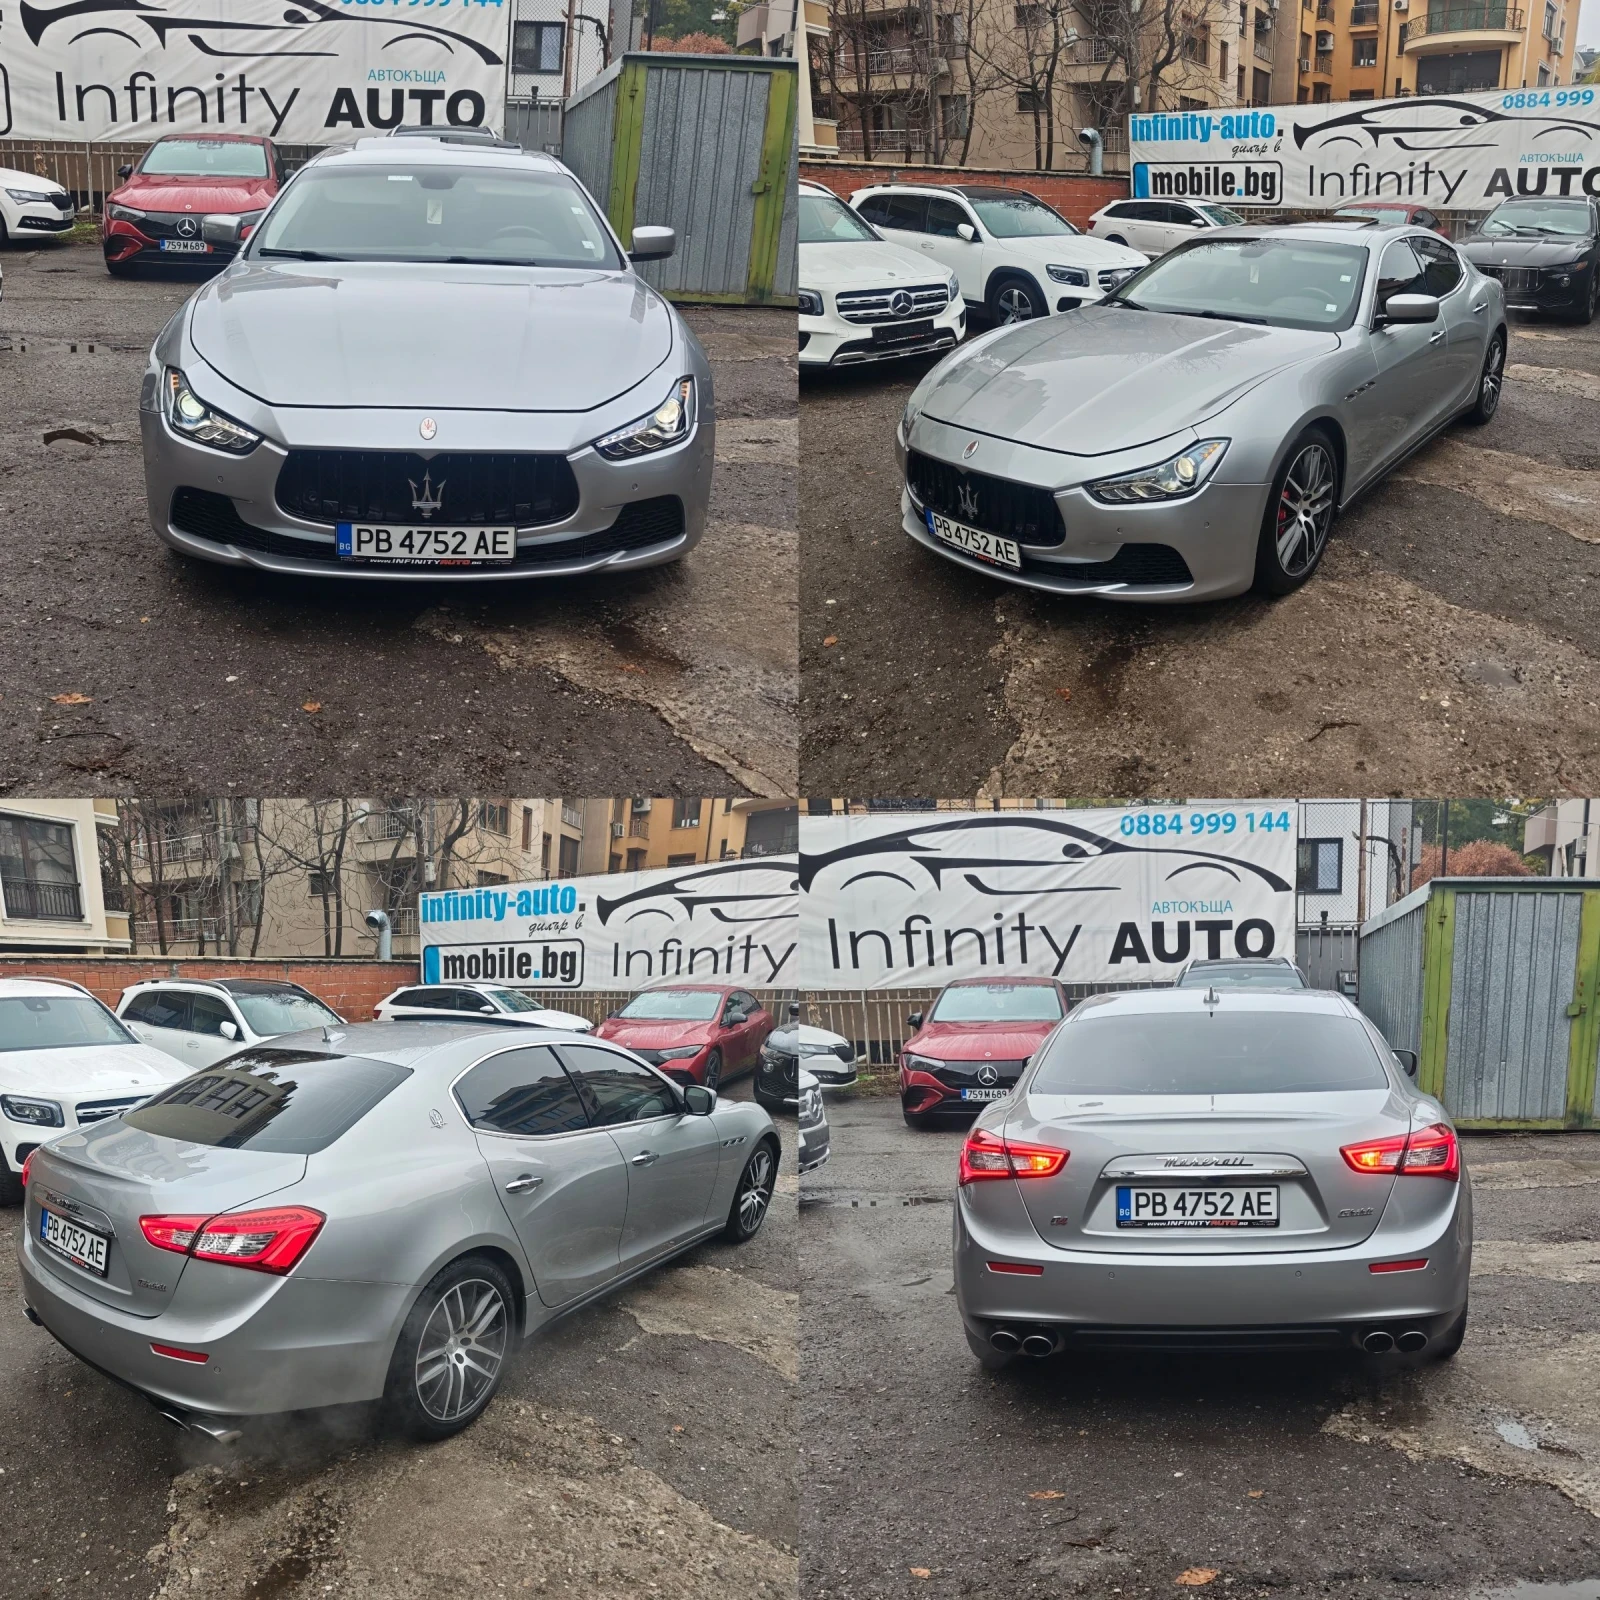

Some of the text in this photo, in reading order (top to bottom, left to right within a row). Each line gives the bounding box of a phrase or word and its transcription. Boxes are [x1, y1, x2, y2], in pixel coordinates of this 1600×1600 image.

[367, 69, 446, 84] АВТОКЪЩА
[55, 71, 485, 137] Infinity AUTO
[1502, 90, 1594, 109] 0884 999
[1131, 112, 1284, 143] infinity-auto.
[1519, 152, 1584, 163] АВТОКЪЩА
[1151, 166, 1276, 200] mobile.bg
[1308, 161, 1468, 204] Infinity
[339, 528, 509, 555] BG PB 4752 AE
[933, 515, 952, 539] PB
[954, 525, 992, 556] 4752
[995, 538, 1017, 563] AE
[1120, 811, 1290, 836] 0884 999 144
[421, 884, 586, 924] infinity-auto.
[1152, 899, 1234, 914] АВТОКЪЩА
[613, 935, 798, 983] Infinity
[828, 912, 1275, 976] Infinity AUTO
[443, 945, 577, 983] mobile.bg
[1119, 1191, 1273, 1217] BG PB 4752 AE
[47, 1215, 60, 1241] PB
[60, 1224, 86, 1257] 4752
[87, 1237, 104, 1266] AE
